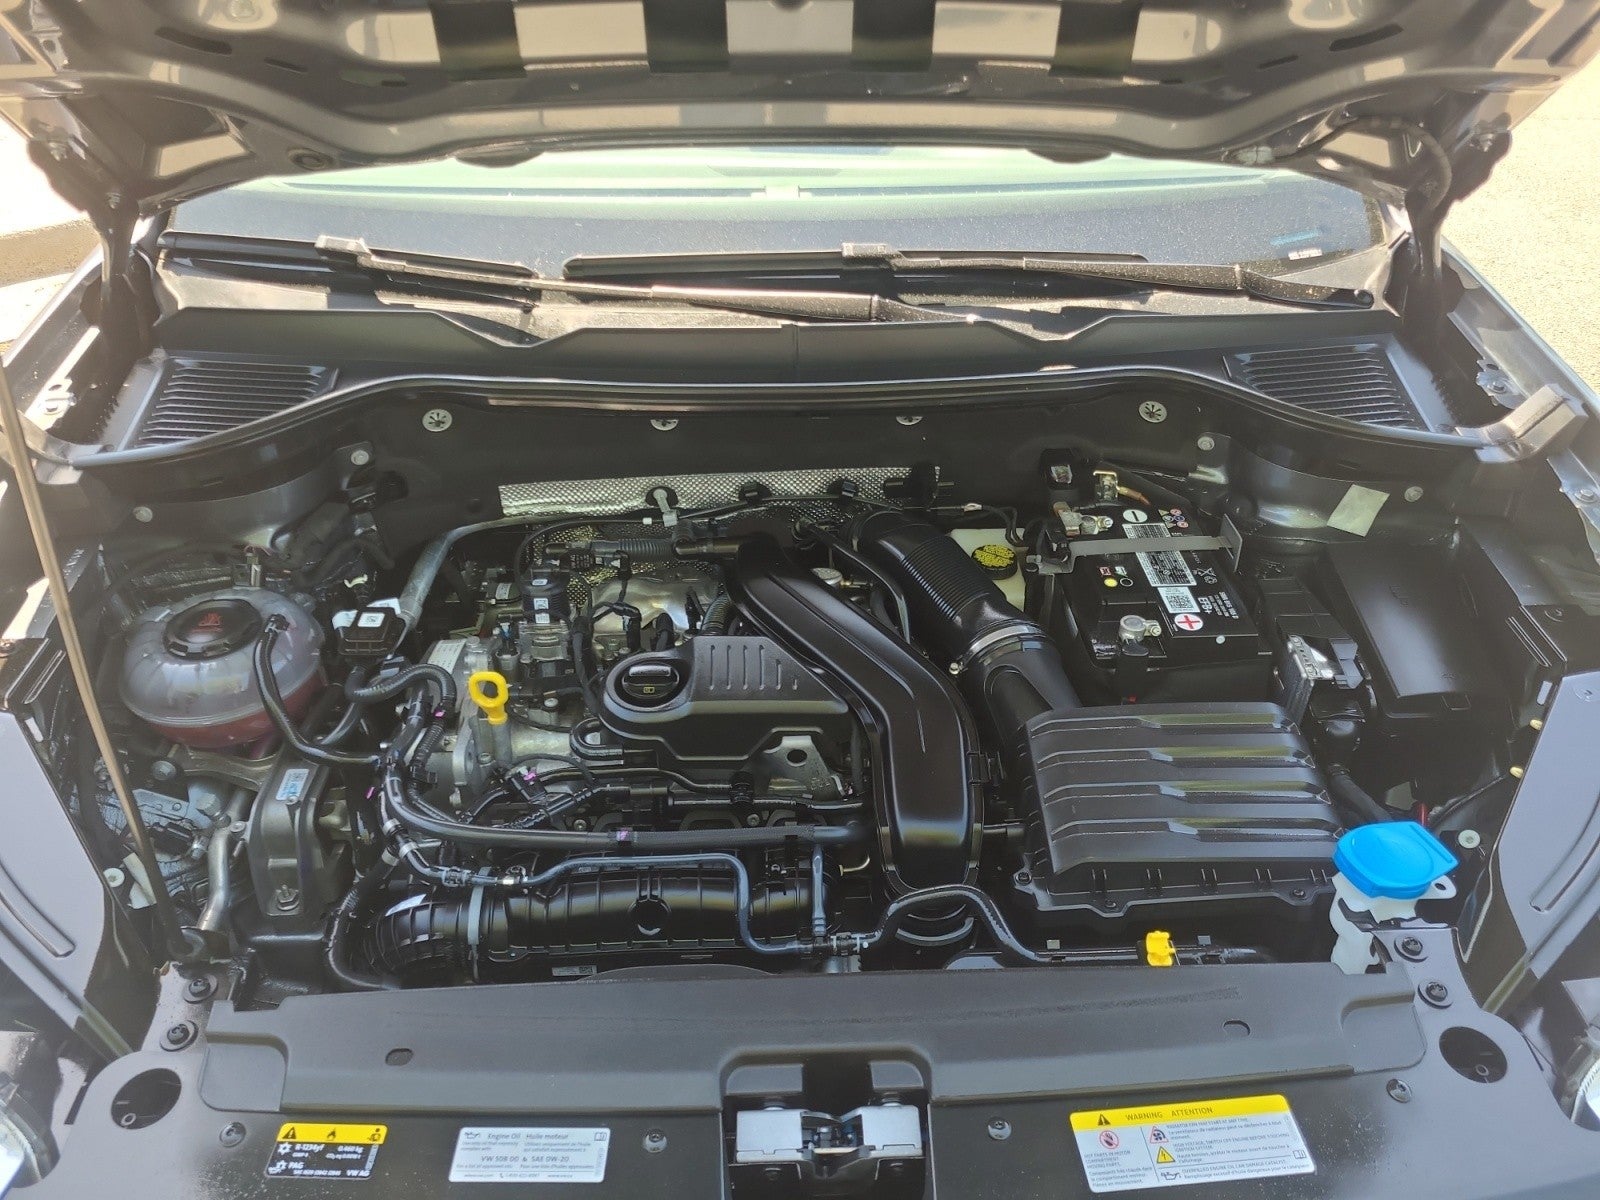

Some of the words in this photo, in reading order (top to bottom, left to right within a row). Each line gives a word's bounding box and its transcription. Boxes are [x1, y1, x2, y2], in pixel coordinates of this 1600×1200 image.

[1125, 1111, 1163, 1122] WARNING
[1171, 1106, 1213, 1117] ATTENTION
[288, 1161, 305, 1170] PAG
[346, 1169, 360, 1177] VW
[358, 1169, 371, 1177] AG
